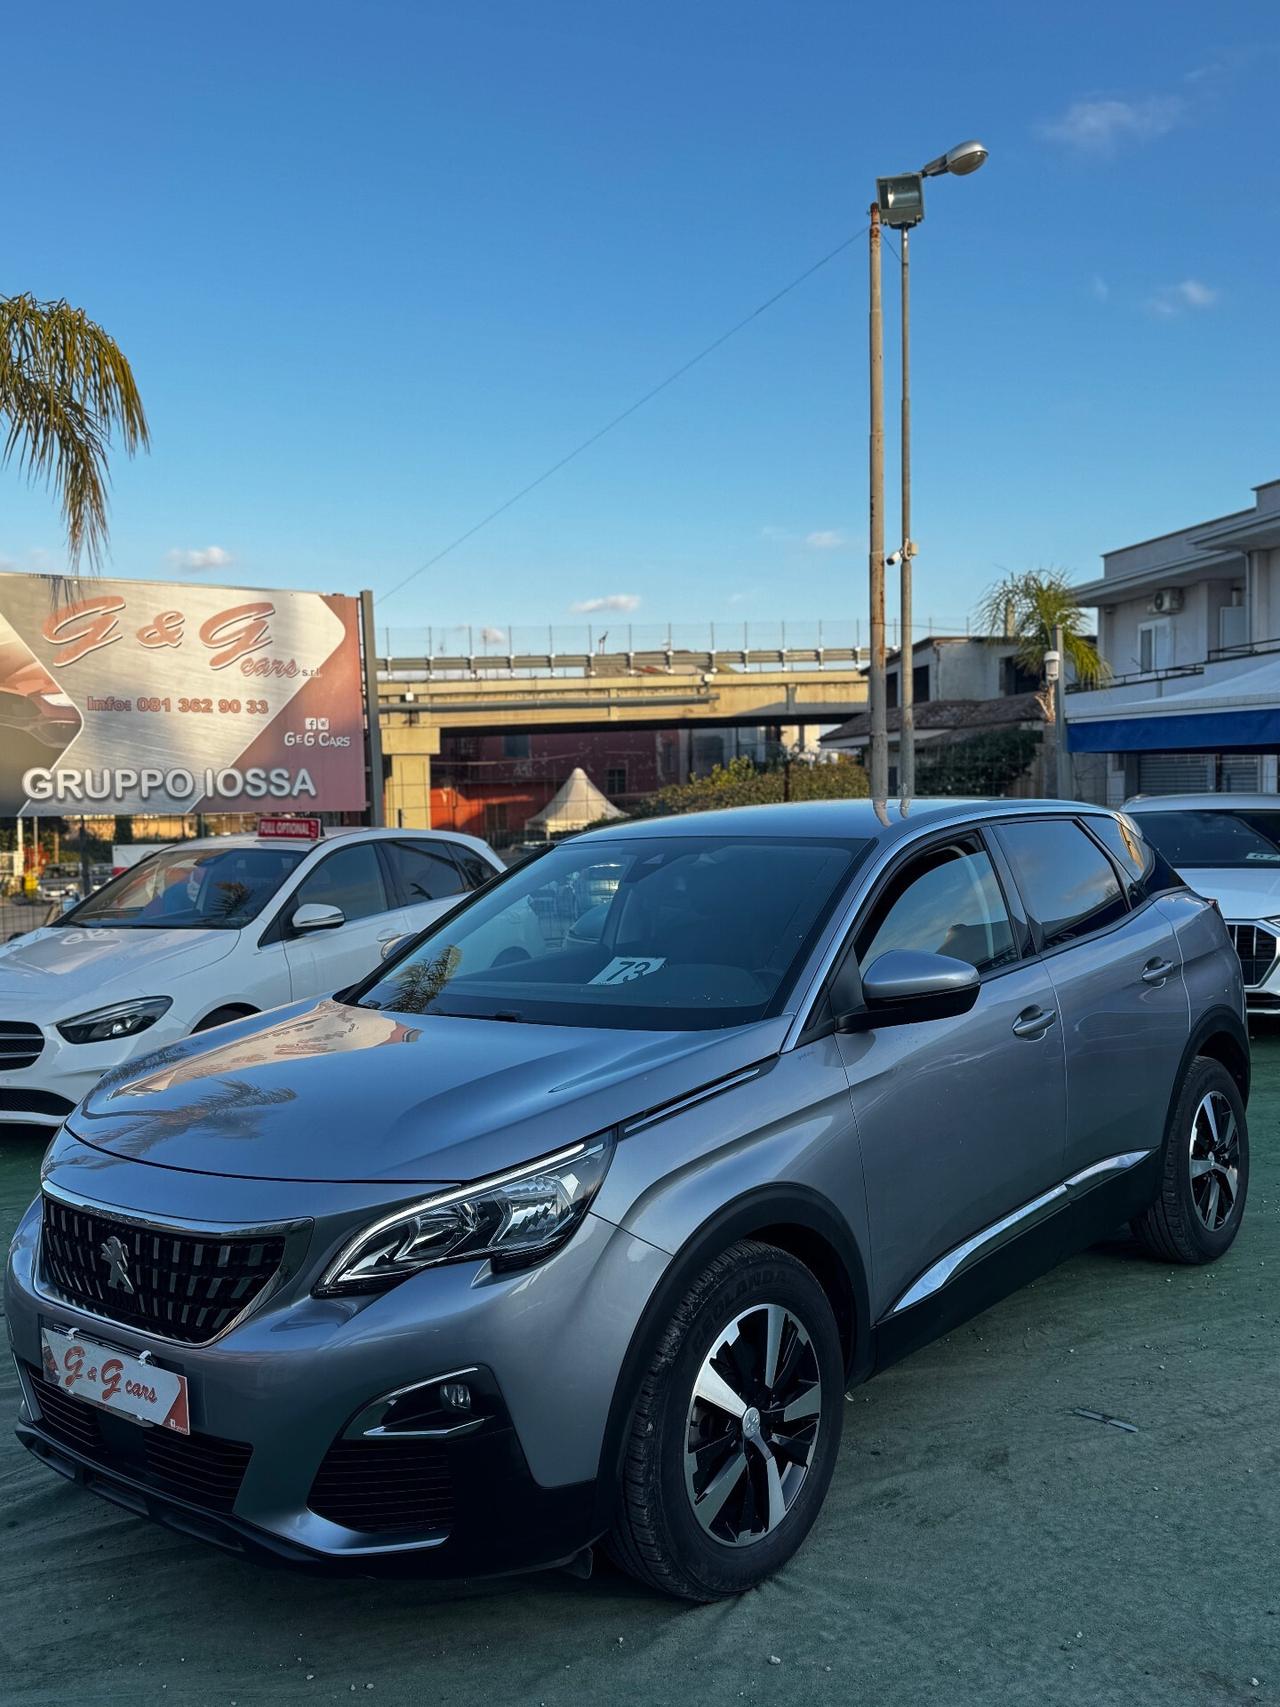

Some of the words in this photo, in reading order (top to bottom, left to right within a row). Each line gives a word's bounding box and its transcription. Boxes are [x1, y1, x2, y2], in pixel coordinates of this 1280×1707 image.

[42, 596, 126, 668] G
[136, 610, 185, 648] &
[199, 601, 275, 670] G
[240, 656, 300, 679] cars
[87, 696, 131, 712] Info:
[137, 697, 171, 713] 081
[178, 698, 213, 713] 362
[218, 699, 241, 714] 90
[246, 700, 269, 715] 33
[22, 767, 195, 801] GRUPPO
[206, 768, 317, 799] IOSSA
[260, 821, 276, 833] FULL
[276, 821, 309, 834] OPTIONAL
[606, 961, 651, 982] 73
[64, 1345, 85, 1387] G
[87, 1366, 97, 1382] &
[101, 1359, 124, 1401] G
[125, 1380, 158, 1404] cars
